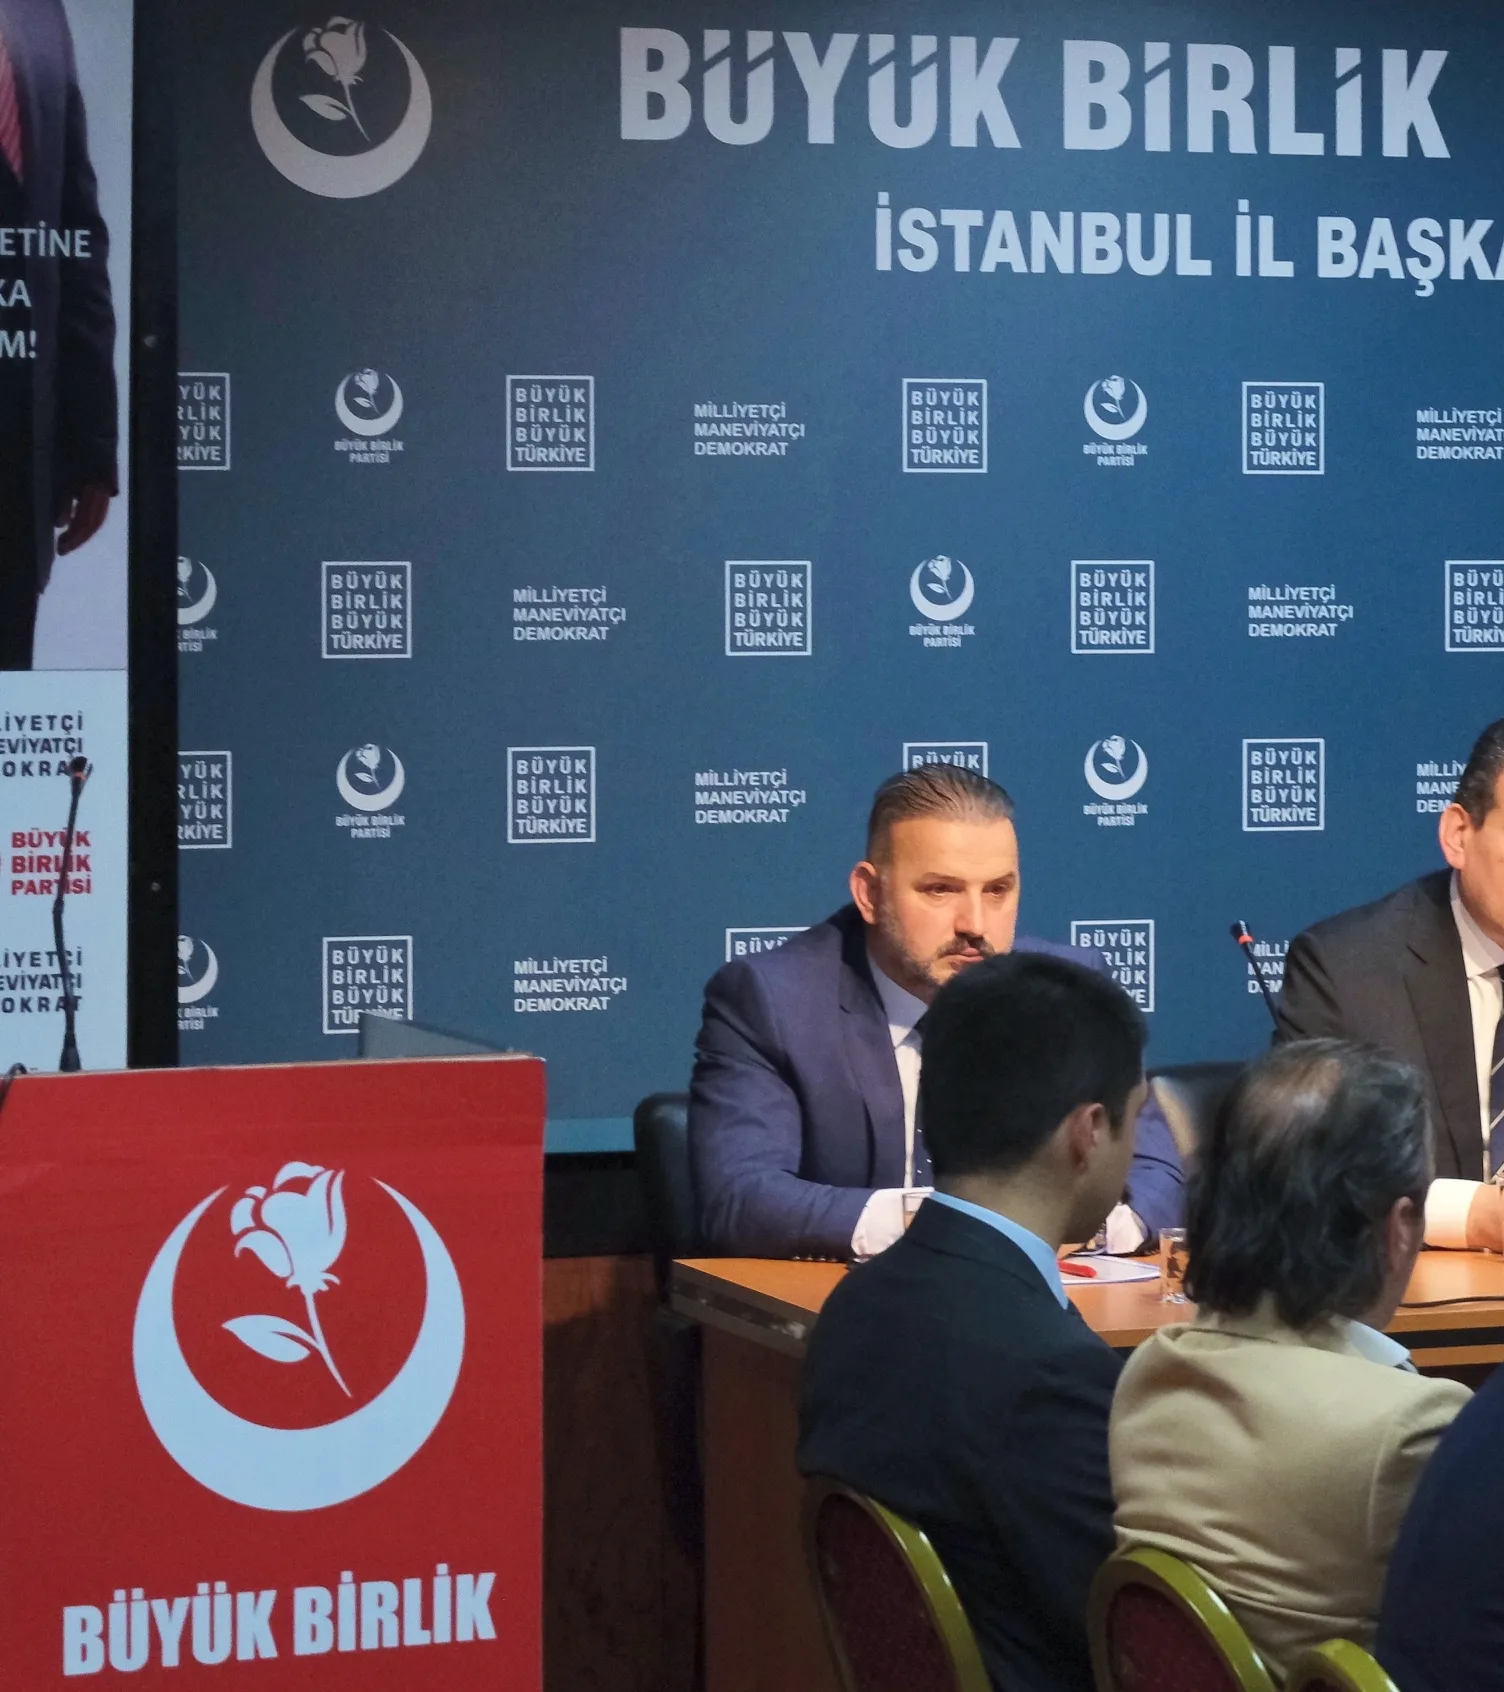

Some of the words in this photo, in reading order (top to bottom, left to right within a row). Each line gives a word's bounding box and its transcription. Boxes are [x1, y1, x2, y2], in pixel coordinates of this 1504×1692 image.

[621, 28, 1023, 149] BÜYÜK
[1063, 40, 1451, 158] BİRLİK
[876, 192, 1212, 276] İSTANBUL
[1236, 199, 1294, 277] İL
[179, 382, 221, 400] YÜK
[516, 384, 586, 403] BÜYÜK
[911, 388, 979, 406] BÜYÜK
[1251, 391, 1316, 409] BÜYÜK
[516, 404, 586, 423] BİRLİK
[694, 401, 786, 421] MİLLİYETÇİ
[911, 407, 979, 425] BİRLİK
[1251, 410, 1316, 428] BİRLİK
[1416, 407, 1502, 426] MİLLİYETÇİ
[179, 422, 221, 440] YÜK
[516, 424, 586, 442] BÜYÜK
[694, 422, 805, 440] MANEVİYATÇI
[912, 426, 979, 445] BÜYÜK
[1251, 429, 1316, 447] BÜYÜK
[515, 444, 586, 462] TÜRKİYE
[694, 442, 789, 456] DEMOKRAT
[910, 445, 979, 464] TÜRKİYE
[1250, 448, 1316, 466] TÜRKİYE
[1417, 446, 1504, 460] DEMOKRAT
[331, 571, 403, 589] BÜYÜK
[734, 570, 803, 588] BÜYÜK
[1080, 569, 1146, 587] BÜYÜK
[331, 591, 403, 609] BİRLİK
[513, 585, 606, 606] MİLLİYETÇİ
[734, 589, 803, 608] BİRLİK
[1080, 588, 1146, 606] BİRLİK
[1248, 584, 1335, 603] MİLLİYETÇİ
[331, 611, 403, 629] BÜYÜK
[513, 607, 626, 624] MANEVİYATÇI
[735, 609, 803, 627] BÜYÜK
[1080, 608, 1146, 626] BÜYÜK
[1248, 604, 1353, 621] MANEVİYATÇI
[513, 626, 609, 640] DEMOKRAT
[733, 628, 803, 647] TÜRKİYE
[1079, 626, 1146, 645] TÜRKİYE
[1248, 623, 1338, 637] DEMOKRAT
[330, 631, 403, 649] TÜRKİYE
[0, 710, 83, 735] İYETÇİ
[1251, 747, 1317, 765] BÜYÜK
[2, 760, 71, 777] OKRA
[181, 760, 223, 779] YÜK
[517, 756, 587, 775] BÜYÜK
[1416, 760, 1467, 777] MİLLİY
[695, 768, 787, 788] MİLLİYETÇİ
[1251, 766, 1317, 784] BİRLİK
[517, 775, 587, 794] BİRLİK
[695, 788, 806, 807] MANEVİYATÇI
[1251, 785, 1316, 803] BÜYÜK
[180, 801, 223, 819] YÜK
[517, 795, 587, 814] BÜYÜK
[1250, 804, 1316, 822] TÜRKİYE
[515, 815, 587, 834] TÜRKİYE
[695, 809, 790, 824] DEMOKRAT
[1079, 928, 1147, 948] BÜYÜK
[332, 945, 404, 965] BÜYÜK
[1101, 948, 1147, 966] RLİK
[332, 965, 404, 985] BİRLİK
[514, 956, 607, 976] MİLLİYETÇİ
[514, 975, 627, 994] MANEVİYATÇI
[332, 985, 404, 1005] BÜYÜK
[514, 996, 611, 1012] DEMOKRAT
[63, 1581, 278, 1676] BÜYÜK
[293, 1563, 497, 1656] BİRLİK
